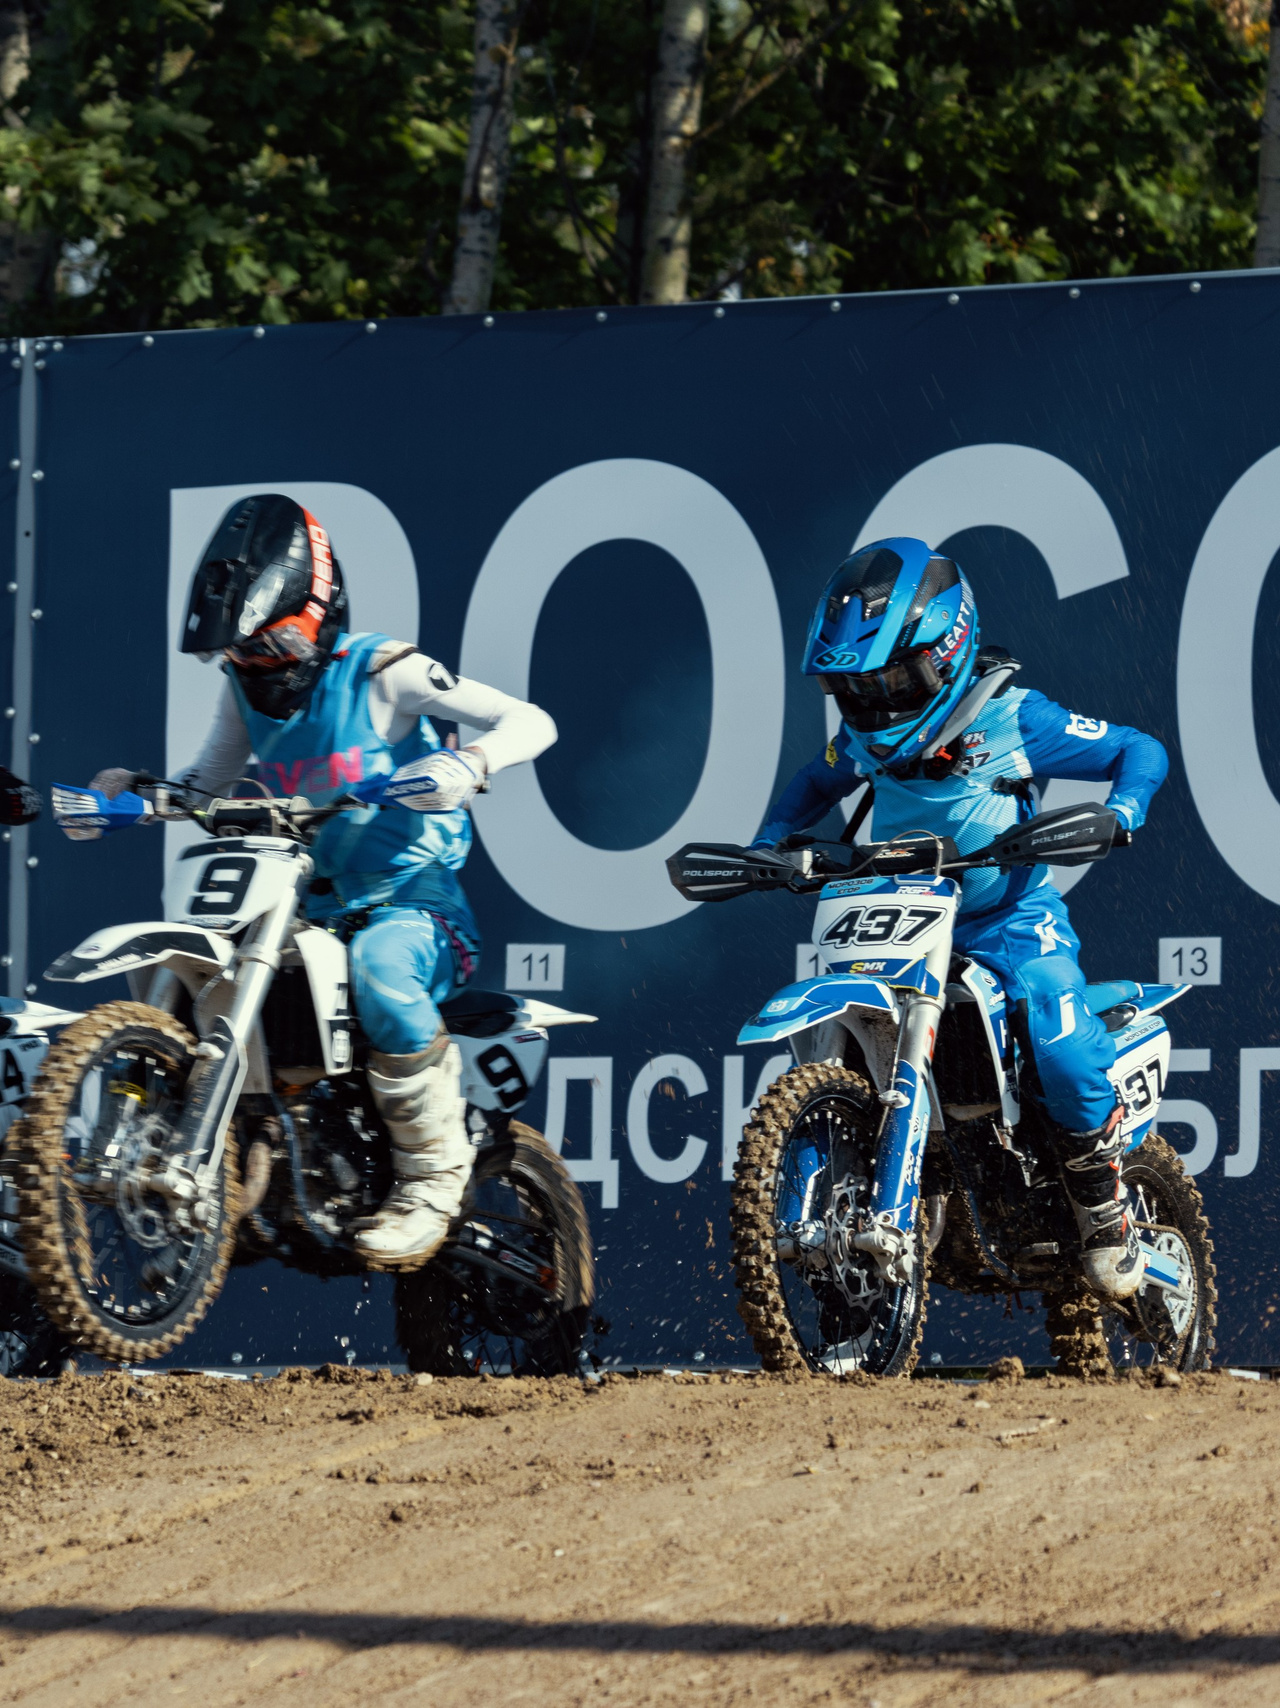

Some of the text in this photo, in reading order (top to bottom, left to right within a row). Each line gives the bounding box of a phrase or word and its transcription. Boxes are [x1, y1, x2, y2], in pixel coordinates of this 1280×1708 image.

[935, 602, 970, 658] LEATT
[682, 869, 744, 877] POLISPORT
[828, 878, 874, 889] МОРОЗОВ
[189, 866, 257, 916] 9
[836, 886, 861, 895] ЕГОР
[821, 905, 947, 948] 437
[522, 953, 549, 982] 11
[849, 962, 887, 974] SMX
[1172, 948, 1208, 977] 13
[477, 1044, 528, 1108] 9
